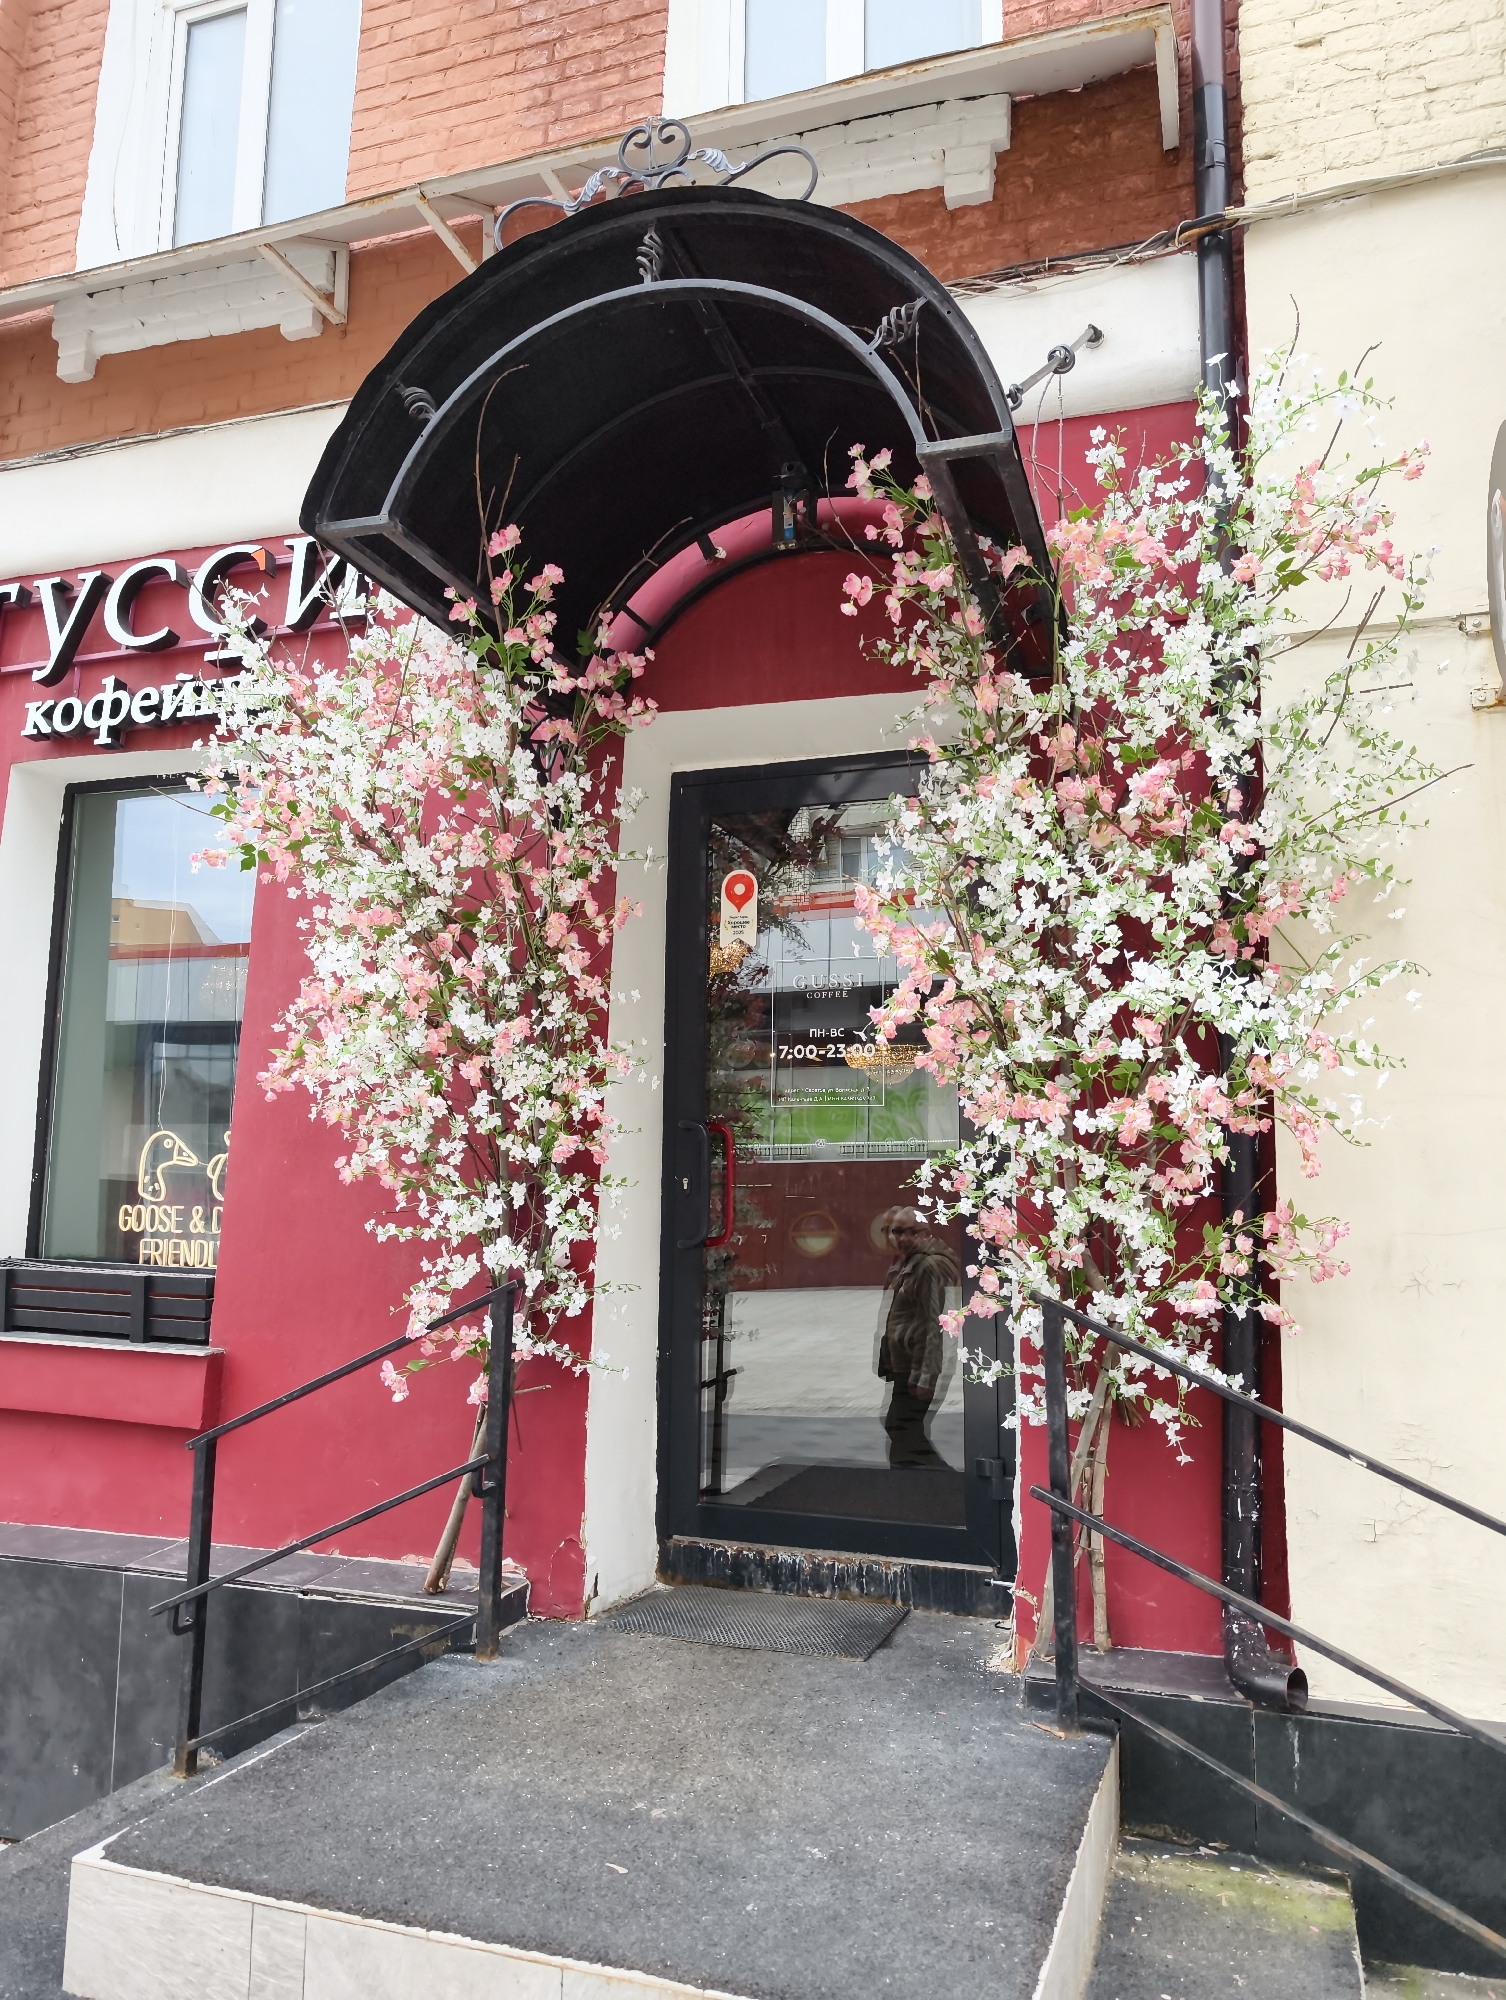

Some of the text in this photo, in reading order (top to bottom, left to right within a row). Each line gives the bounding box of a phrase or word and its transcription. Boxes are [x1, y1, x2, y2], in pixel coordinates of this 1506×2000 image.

[0, 536, 370, 682] усси
[793, 973, 864, 990] GUSSI
[806, 991, 848, 999] COFFEE
[809, 1028, 845, 1038] ПН-ВС
[118, 1204, 184, 1233] GOOSE
[189, 1205, 206, 1234] &
